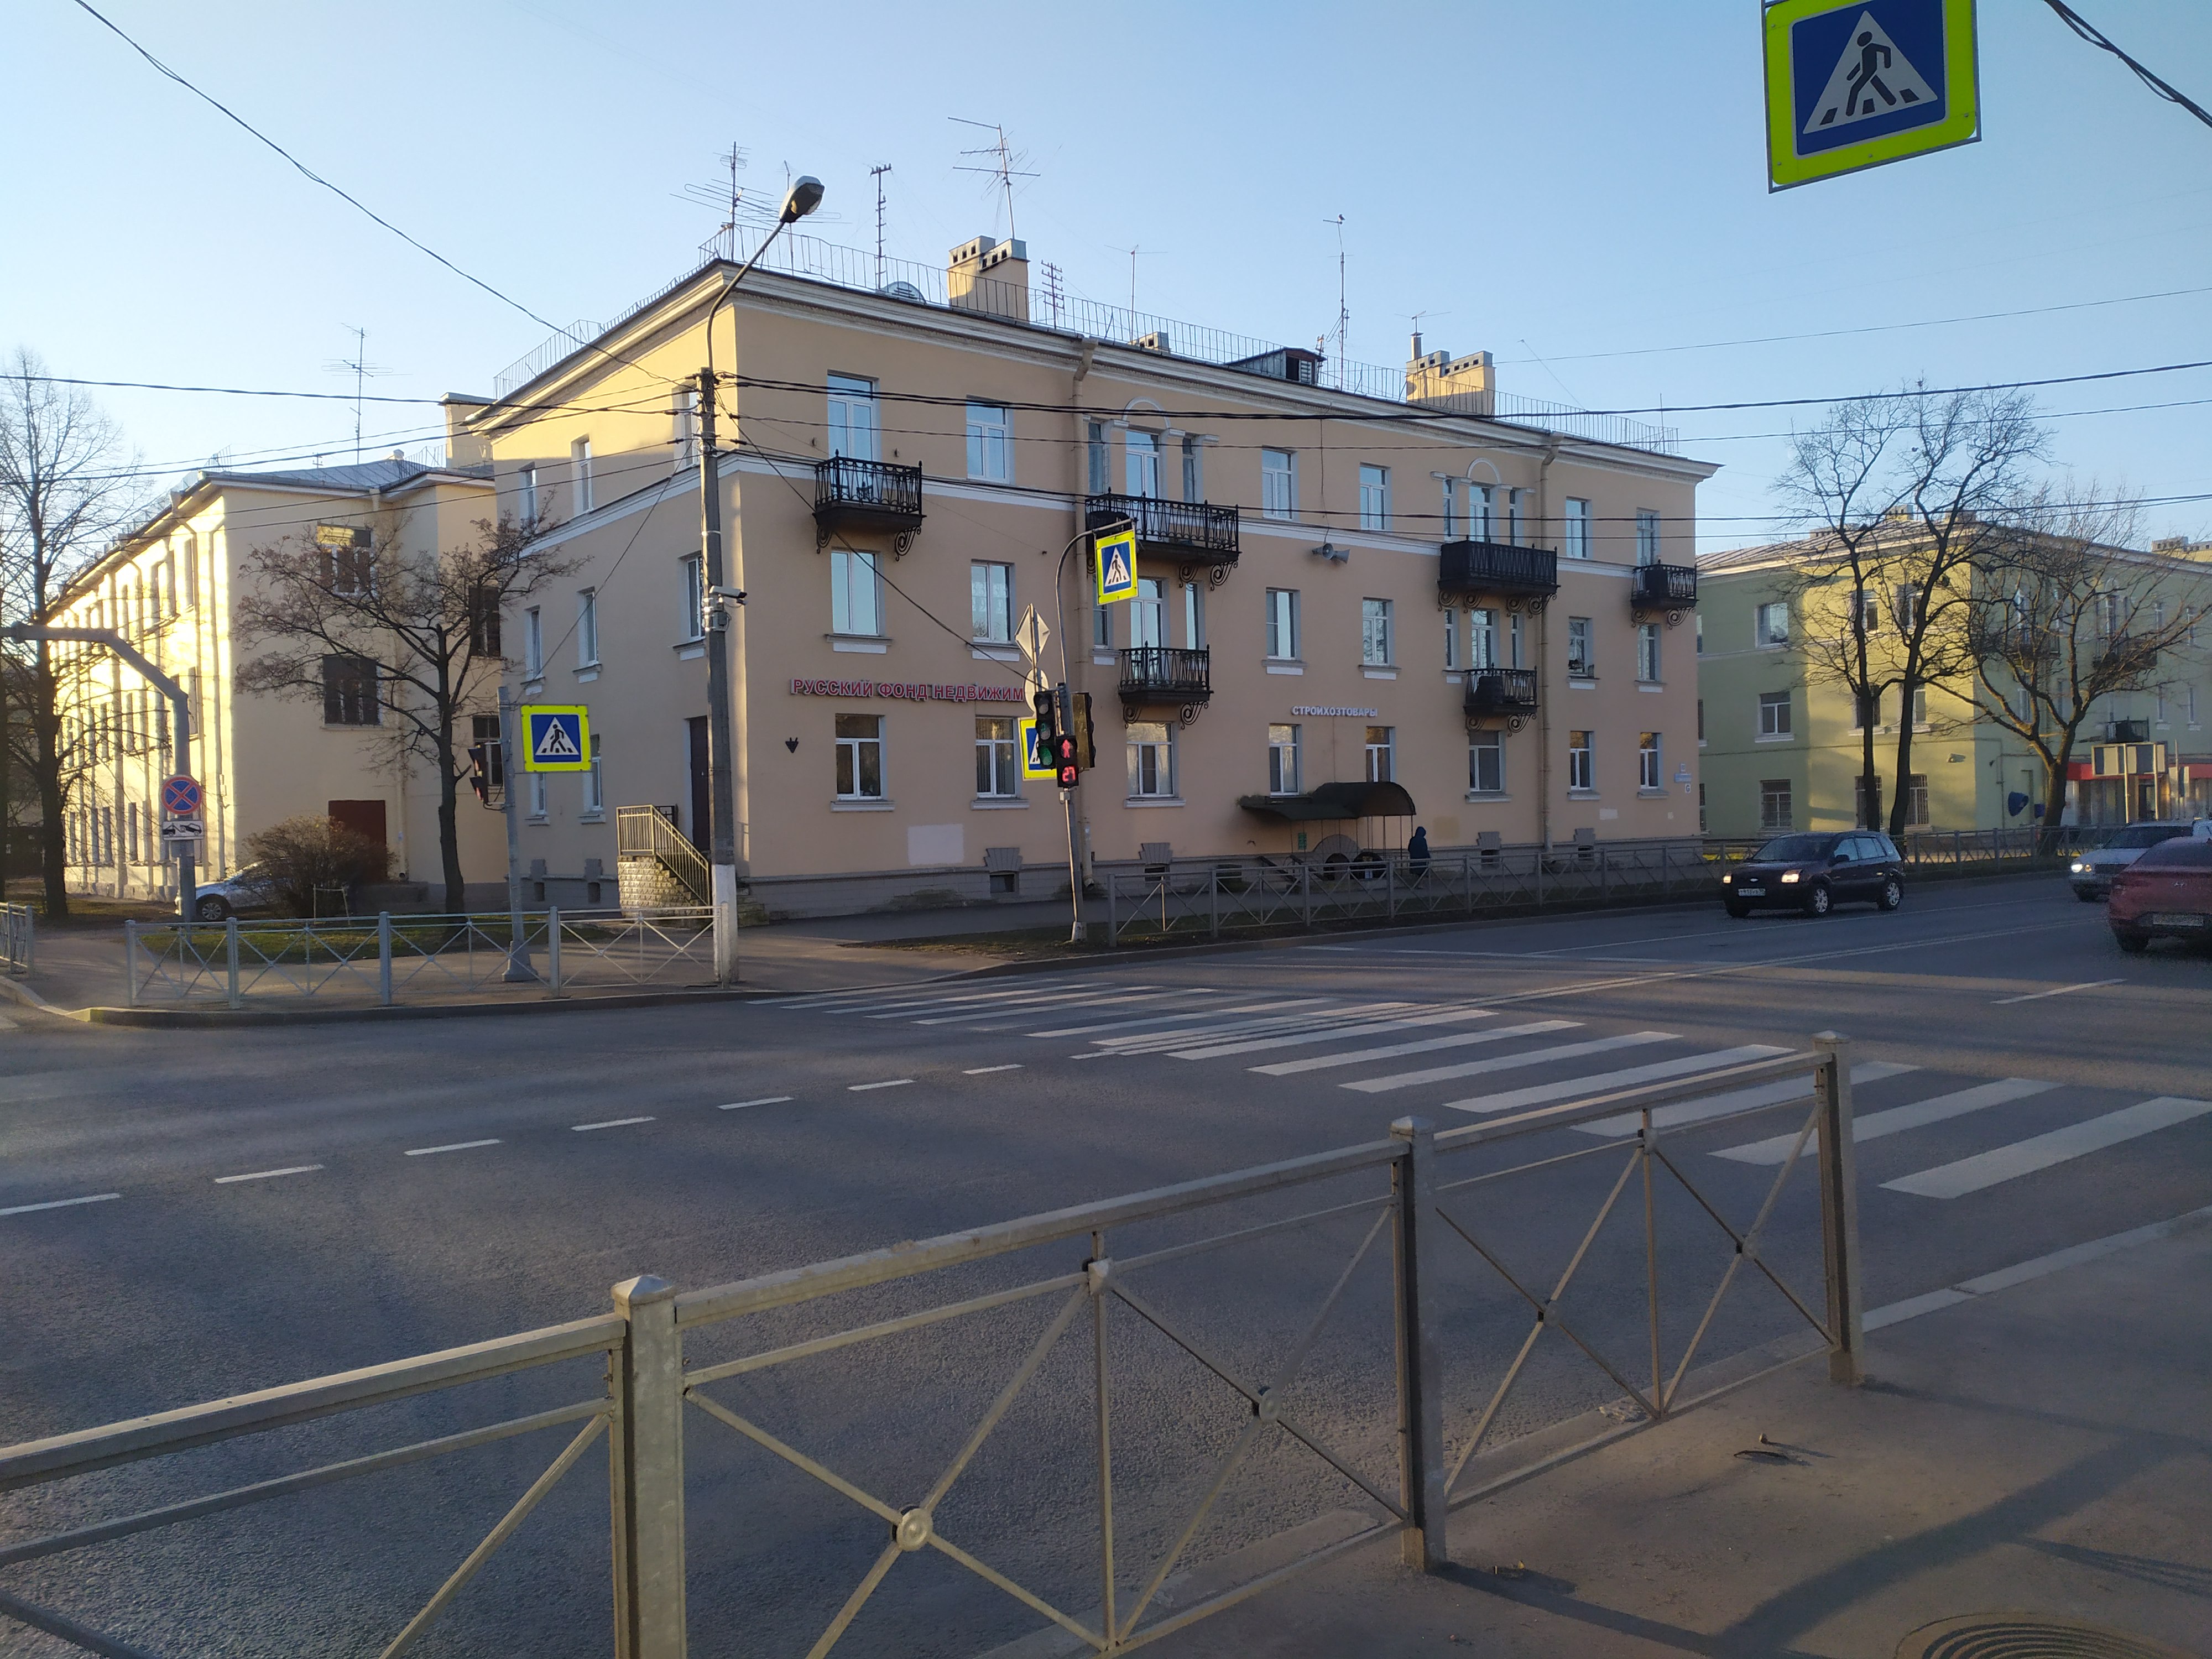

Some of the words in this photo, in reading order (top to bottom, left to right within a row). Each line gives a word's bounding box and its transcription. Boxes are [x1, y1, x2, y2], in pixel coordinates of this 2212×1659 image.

[791, 679, 873, 697] РУССКИЙ
[878, 682, 928, 701] ФОНД
[932, 684, 1024, 702] НЕДВИЖИМ
[1292, 706, 1378, 717] СТРОЙХОЗТОВАРЫ
[1062, 765, 1076, 782] 27
